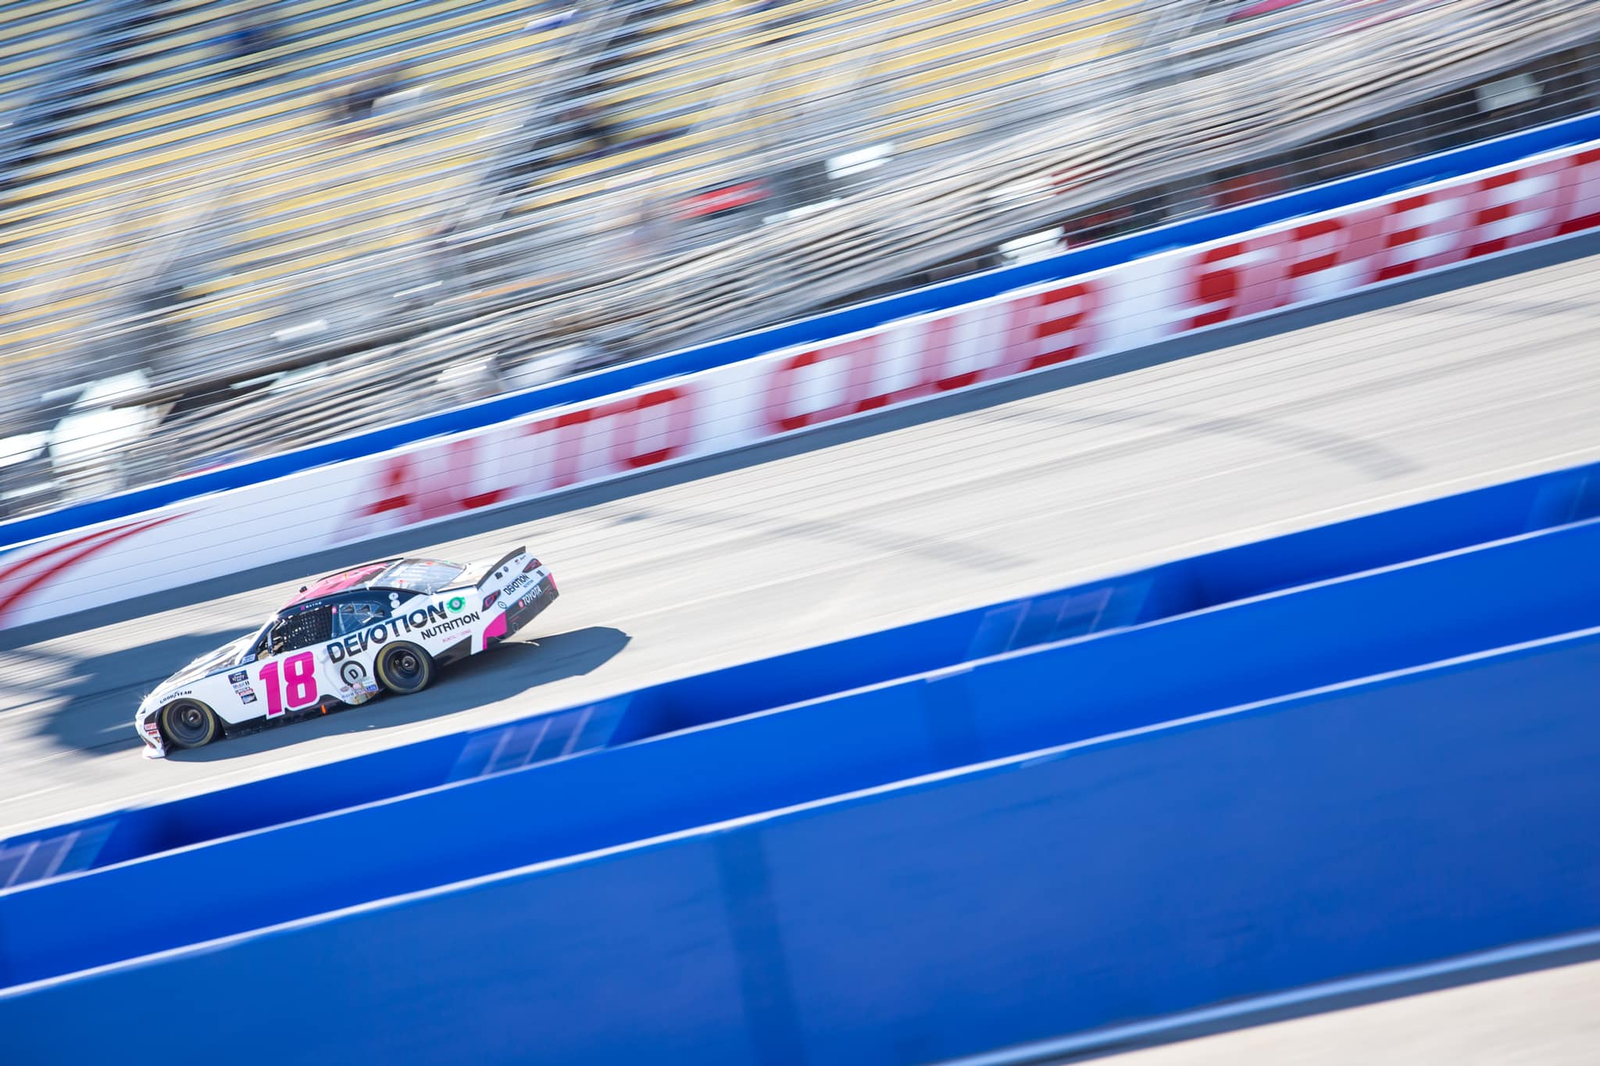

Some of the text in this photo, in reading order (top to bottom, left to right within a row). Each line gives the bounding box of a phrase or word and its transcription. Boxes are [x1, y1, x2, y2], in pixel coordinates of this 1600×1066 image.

[326, 601, 448, 664] DEVOTION
[420, 611, 480, 640] NUTRITION
[259, 651, 318, 716] 18
